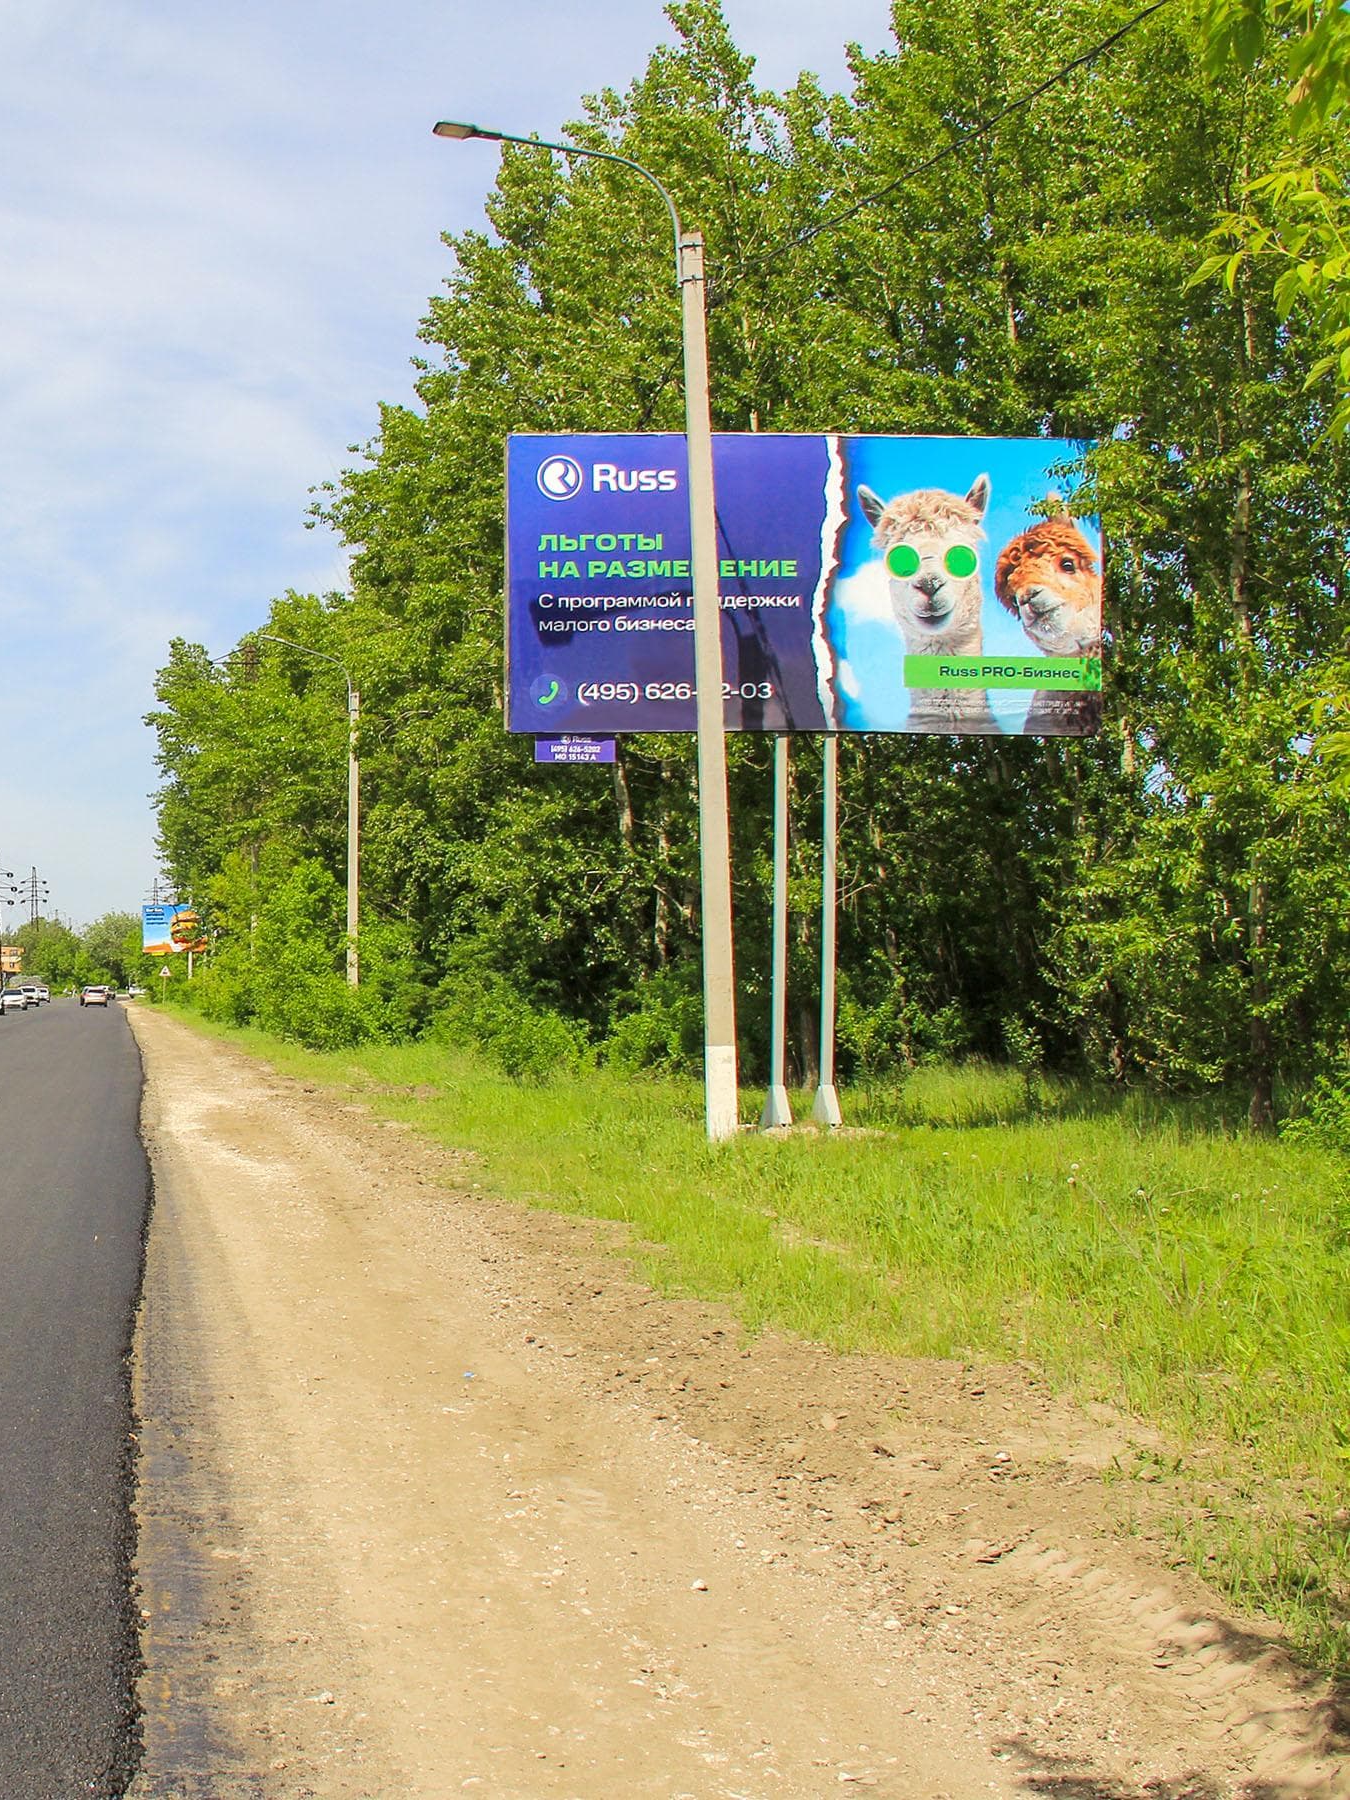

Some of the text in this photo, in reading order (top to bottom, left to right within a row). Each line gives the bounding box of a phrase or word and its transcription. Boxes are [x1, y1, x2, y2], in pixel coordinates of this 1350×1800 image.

[593, 463, 677, 492] Russ
[538, 533, 663, 552] ЛЬГОТЫ
[539, 560, 798, 578] НА РАЗМЕЕНИЕ
[538, 592, 800, 611] С программой пдержки
[539, 616, 696, 632] малого бизнеса
[939, 666, 1080, 679] Russ PRO-Бизнес
[577, 682, 773, 706] (495) 626-2-03
